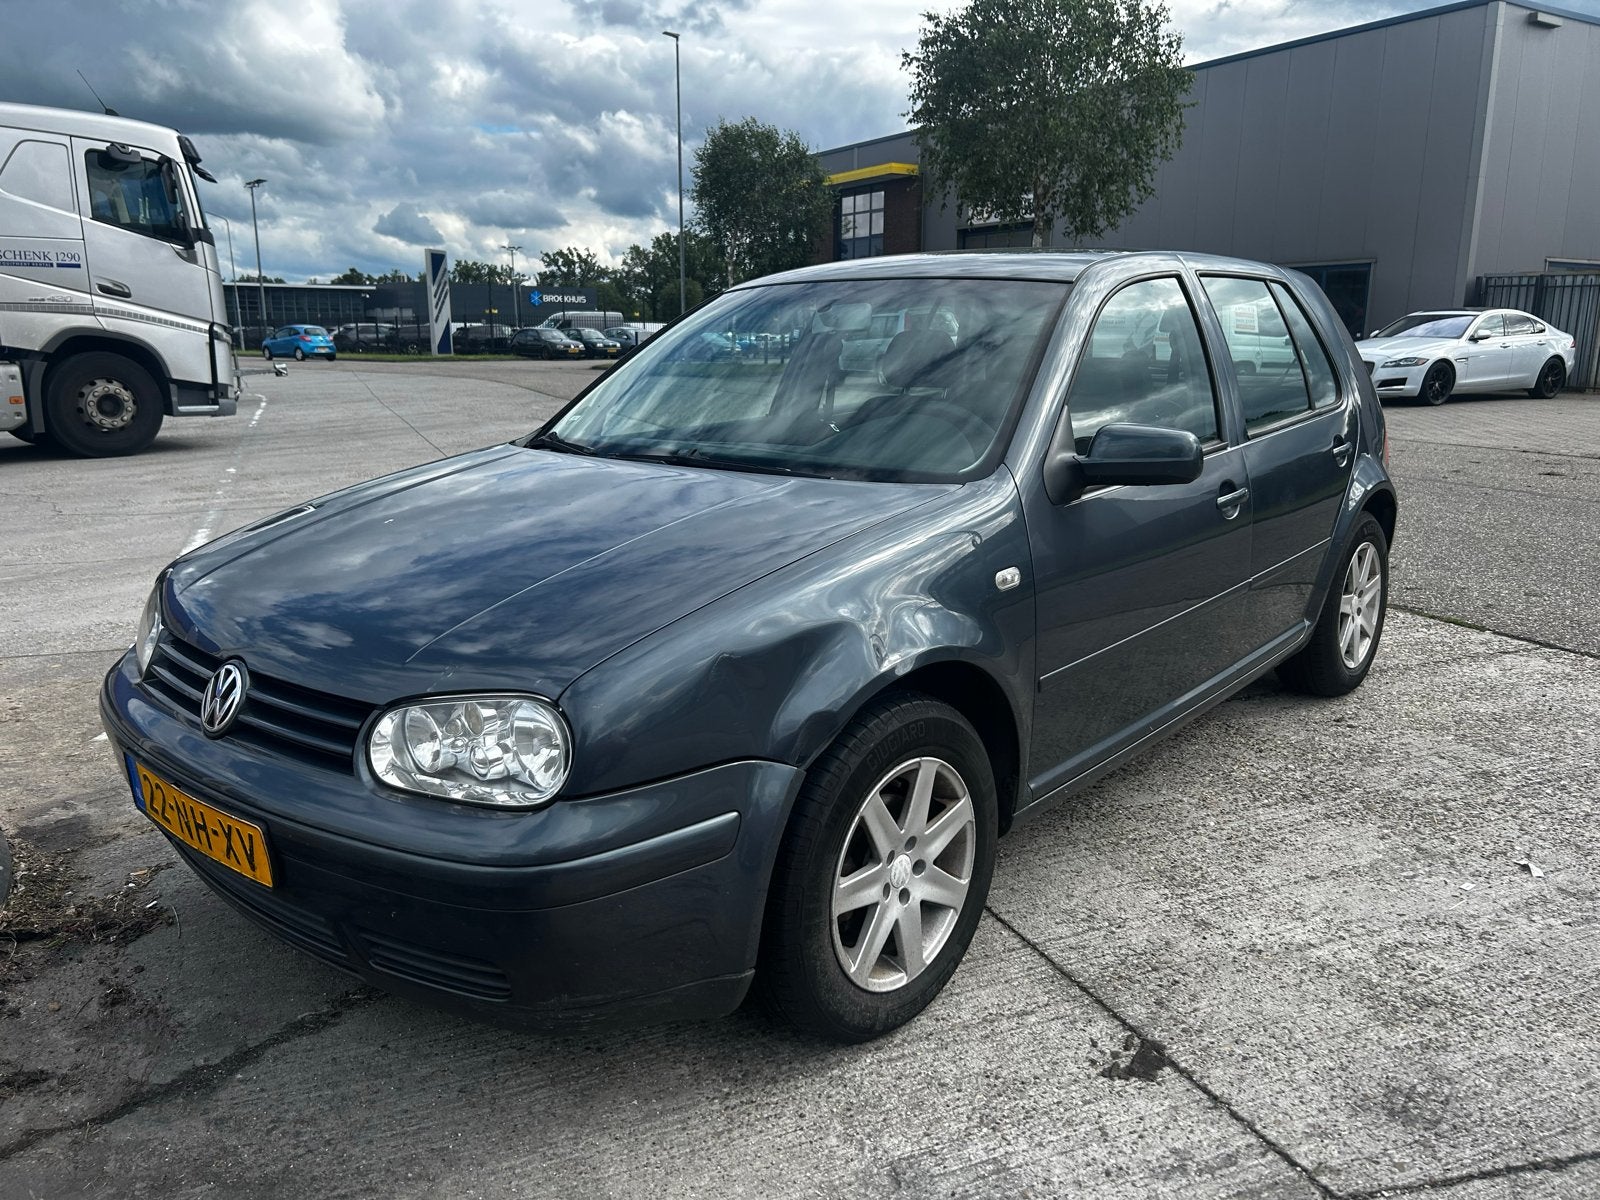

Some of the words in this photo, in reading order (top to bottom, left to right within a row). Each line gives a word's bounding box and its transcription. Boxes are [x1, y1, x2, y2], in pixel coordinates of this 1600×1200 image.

[55, 252, 81, 262] 1290
[542, 294, 587, 304] BROEKHUIS
[142, 773, 256, 873] 22-NH-XV
